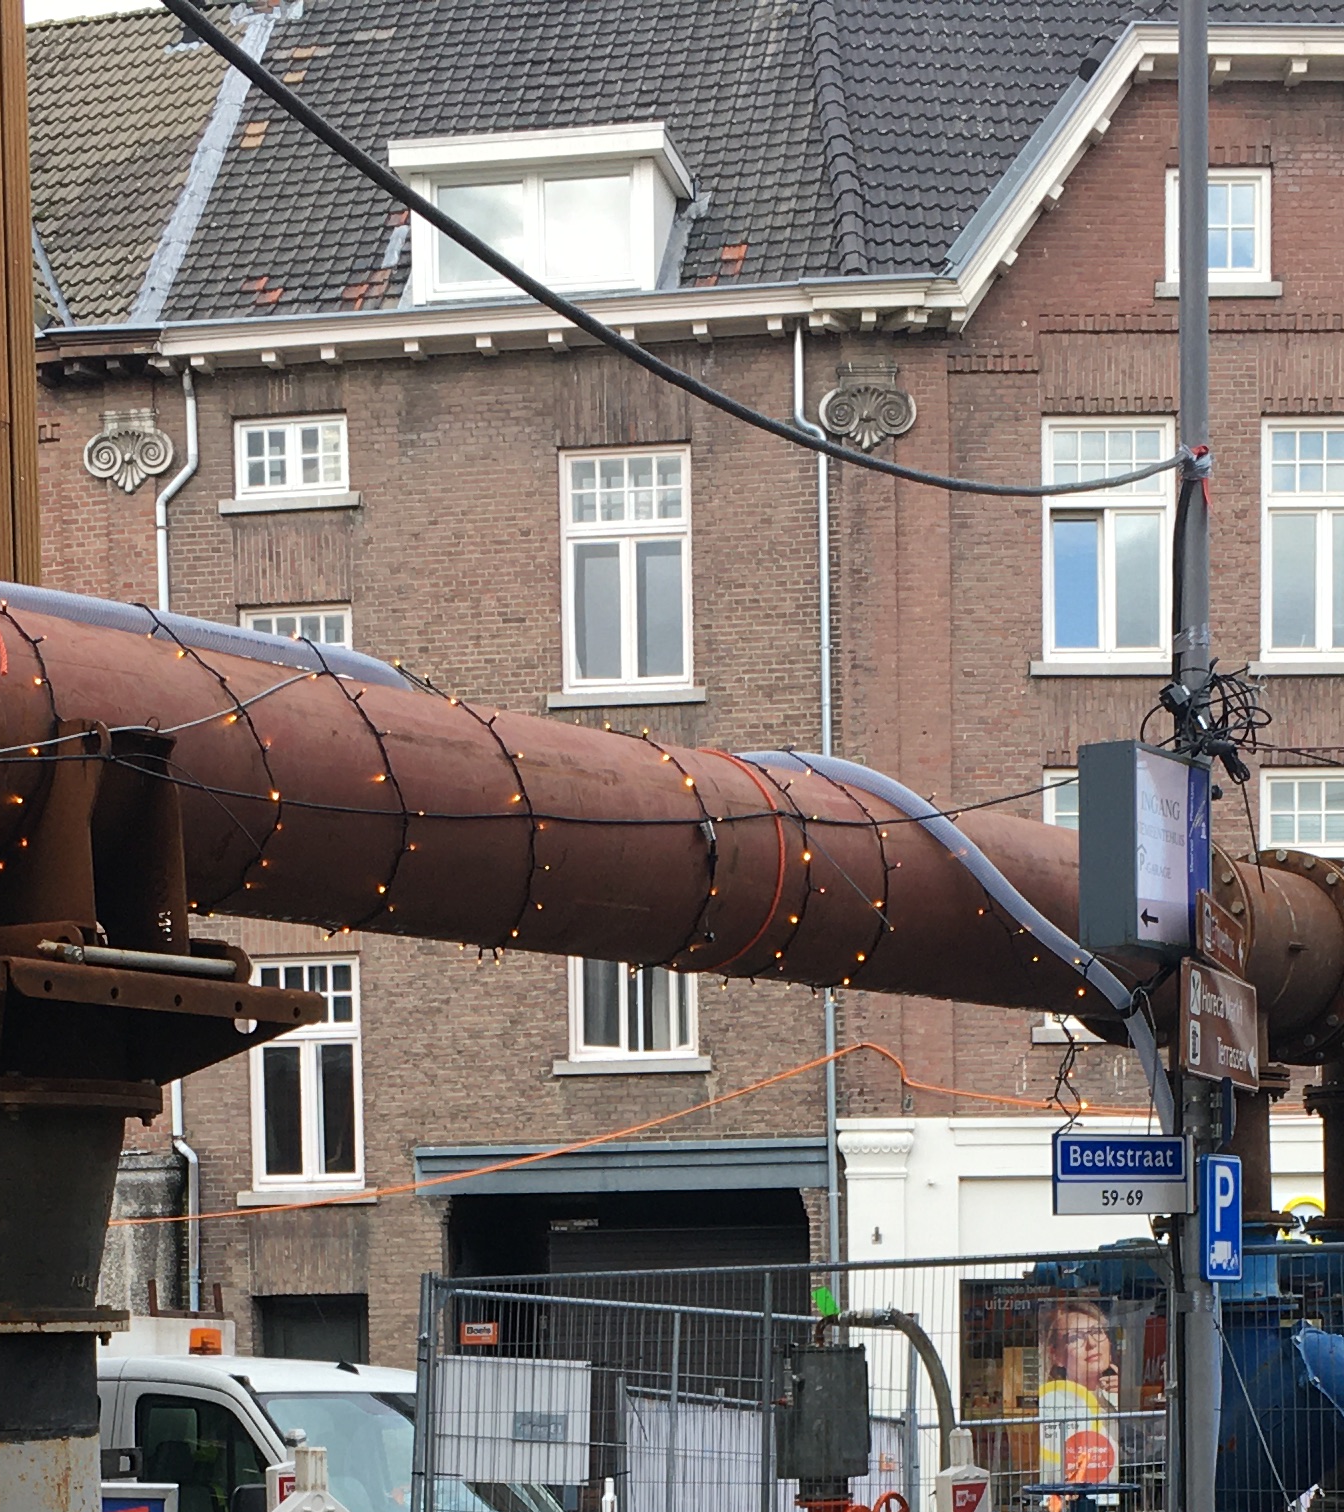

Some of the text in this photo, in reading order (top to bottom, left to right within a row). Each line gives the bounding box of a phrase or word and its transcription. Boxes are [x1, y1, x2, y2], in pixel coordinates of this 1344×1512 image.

[1141, 790, 1181, 821] INGANG
[1201, 983, 1244, 1026] Horeca Markt
[1217, 1036, 1248, 1072] Terrassen
[1069, 1145, 1174, 1169] Beekstraat
[1102, 1189, 1144, 1207] 59-69
[1215, 1165, 1234, 1232] P
[985, 1296, 1031, 1310] uitzien
